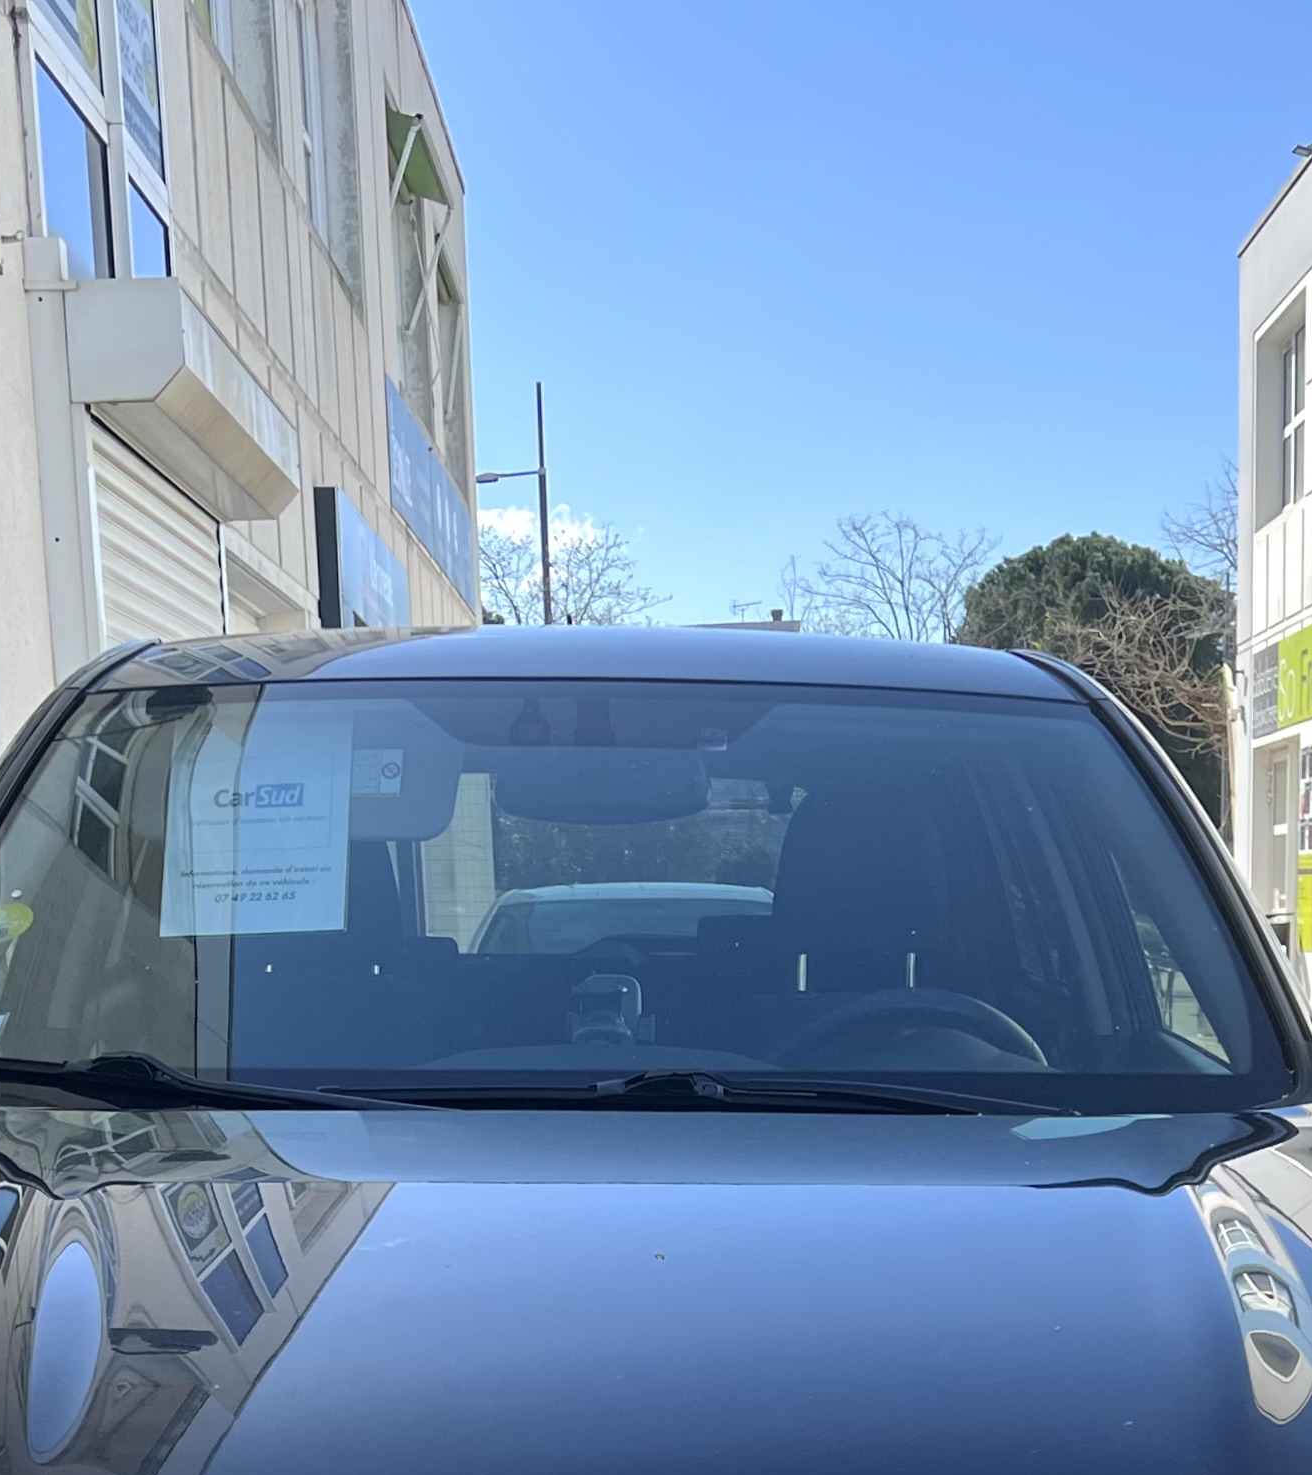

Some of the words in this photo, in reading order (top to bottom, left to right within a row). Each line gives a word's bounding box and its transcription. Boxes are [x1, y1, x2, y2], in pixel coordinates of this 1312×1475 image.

[213, 783, 302, 808] CarSud
[214, 894, 229, 903] 07
[231, 892, 247, 902] 49
[249, 892, 262, 901] 22
[265, 891, 278, 901] 62
[281, 890, 297, 900] 65
